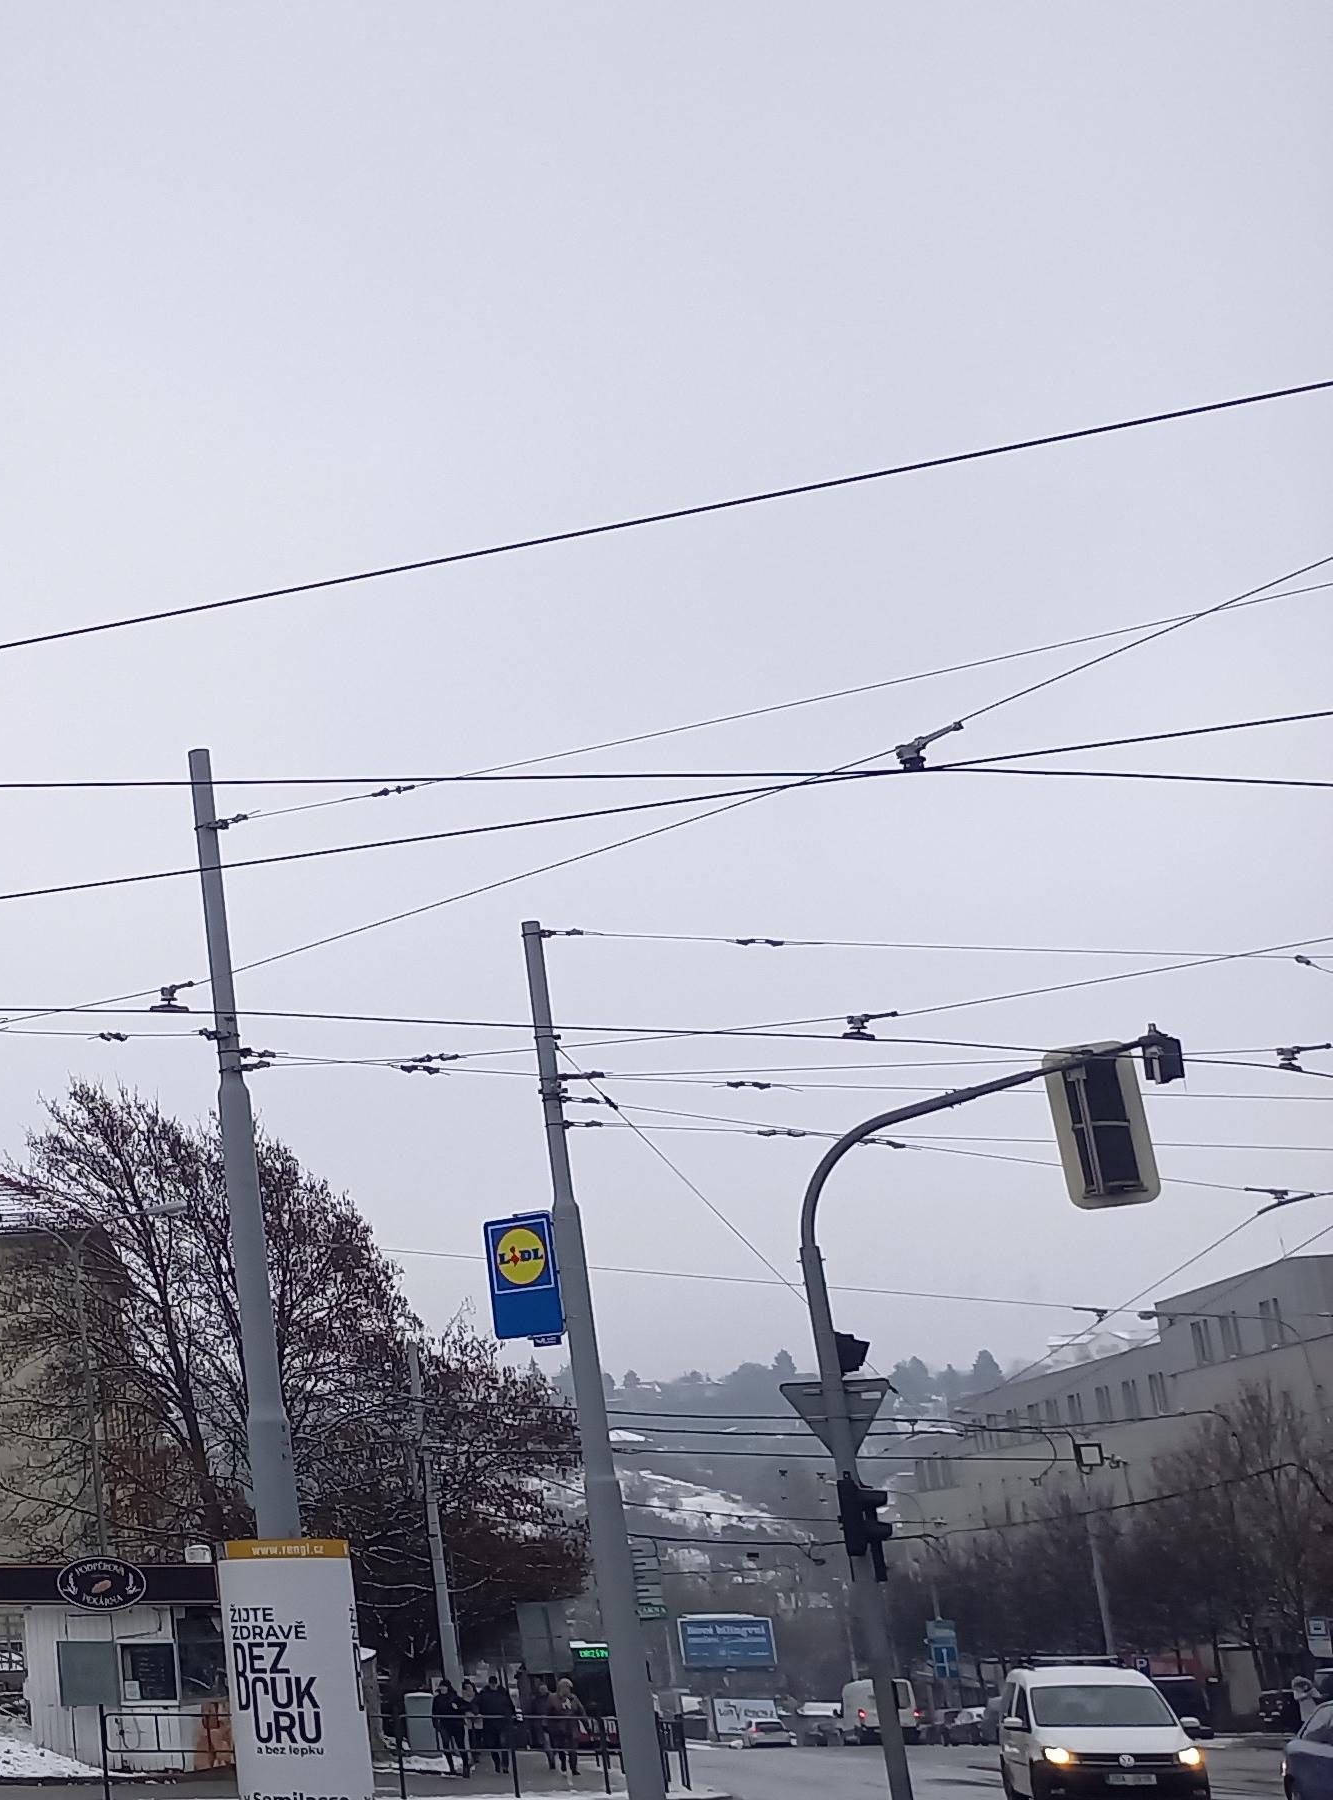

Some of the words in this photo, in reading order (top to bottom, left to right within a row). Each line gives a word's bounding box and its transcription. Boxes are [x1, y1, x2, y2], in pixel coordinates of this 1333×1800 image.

[251, 1544, 324, 1556] www.rengl.cz
[230, 1604, 274, 1623] ŽIJTE
[231, 1621, 307, 1640] ZDRAVĚ
[266, 1745, 286, 1755] bez
[288, 1745, 324, 1756] lepku
